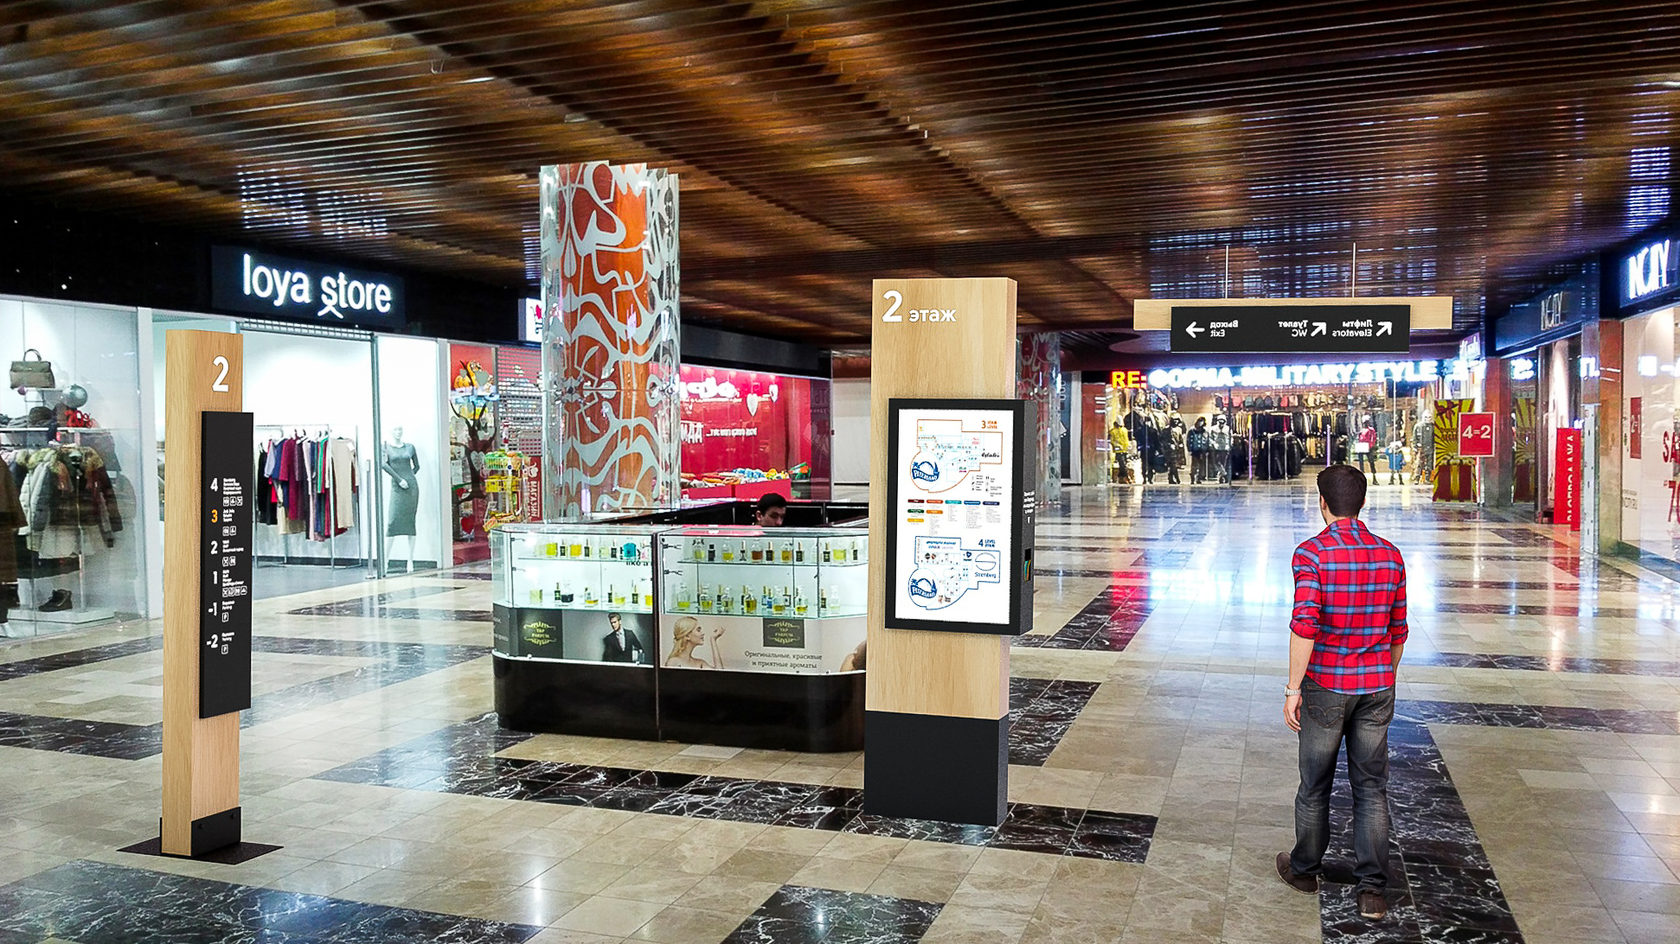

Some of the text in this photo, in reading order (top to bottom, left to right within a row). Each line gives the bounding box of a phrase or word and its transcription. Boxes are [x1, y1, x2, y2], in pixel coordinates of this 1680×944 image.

[243, 253, 393, 319] loya store
[882, 290, 957, 323] 2 этаж
[212, 355, 230, 393] 2
[1462, 425, 1491, 439] 4=2
[210, 477, 219, 492] 4
[530, 480, 538, 517] МАГАЗИН
[211, 508, 218, 524] 3
[210, 540, 218, 555] 2
[213, 570, 218, 585] 1
[208, 602, 218, 617] -1
[206, 633, 219, 649] -2
[744, 650, 823, 661] Оригинальные, красивые
